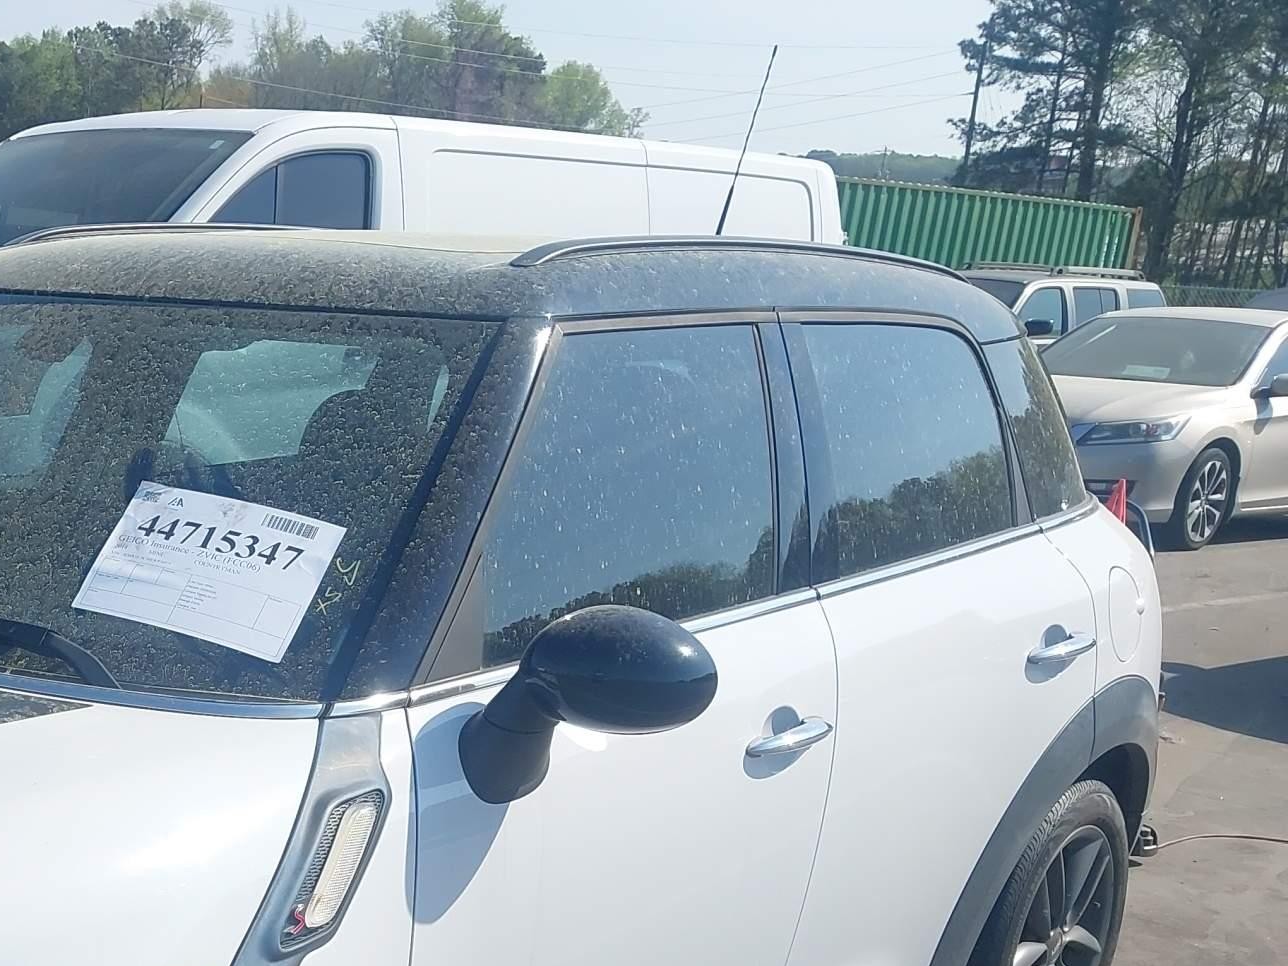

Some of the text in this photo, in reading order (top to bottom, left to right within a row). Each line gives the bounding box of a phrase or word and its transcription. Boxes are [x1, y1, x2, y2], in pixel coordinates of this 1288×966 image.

[118, 534, 149, 545] GEICO
[150, 540, 189, 554] Insurance
[137, 515, 305, 570] 44715347
[193, 559, 241, 575] COUNTRYMAN
